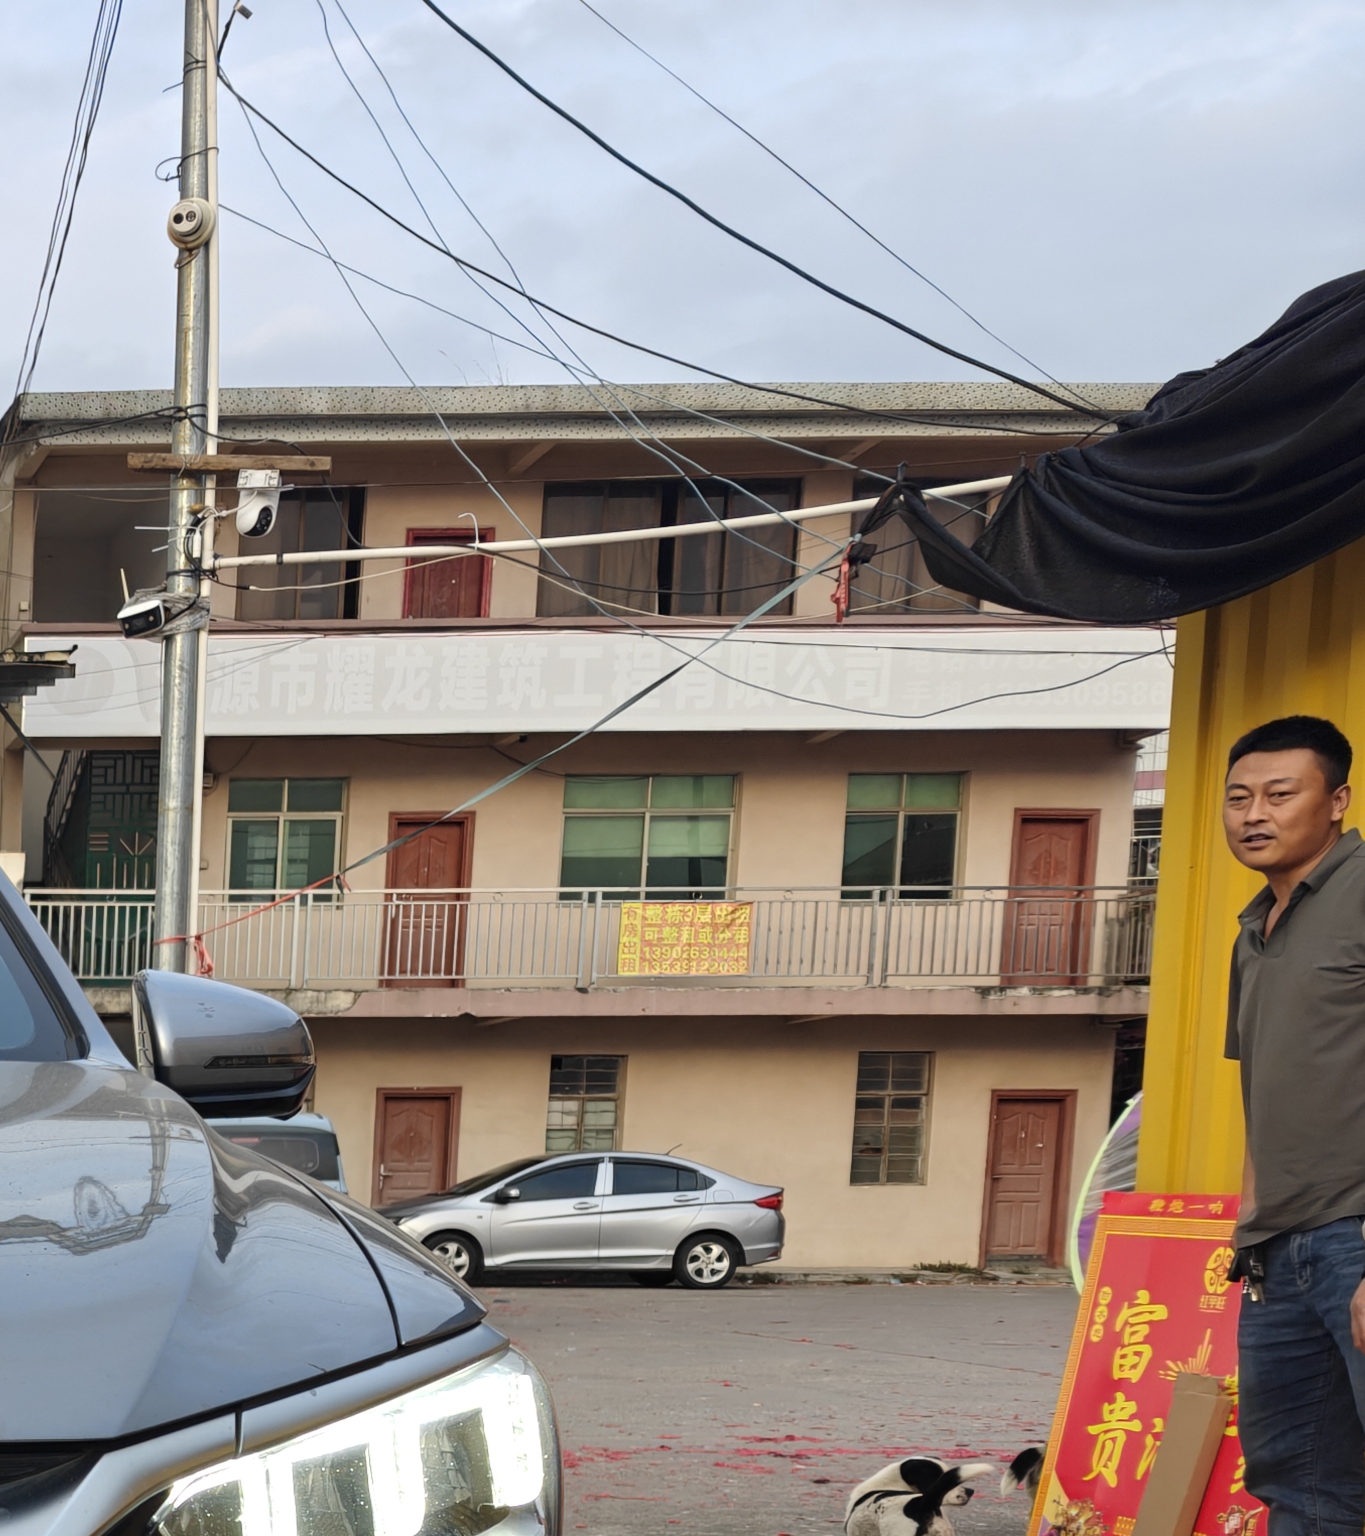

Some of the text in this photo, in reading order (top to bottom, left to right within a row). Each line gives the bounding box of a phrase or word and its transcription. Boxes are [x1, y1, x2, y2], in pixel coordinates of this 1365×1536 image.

[155, 641, 892, 714] 源市耀龙建筑工程有限公司
